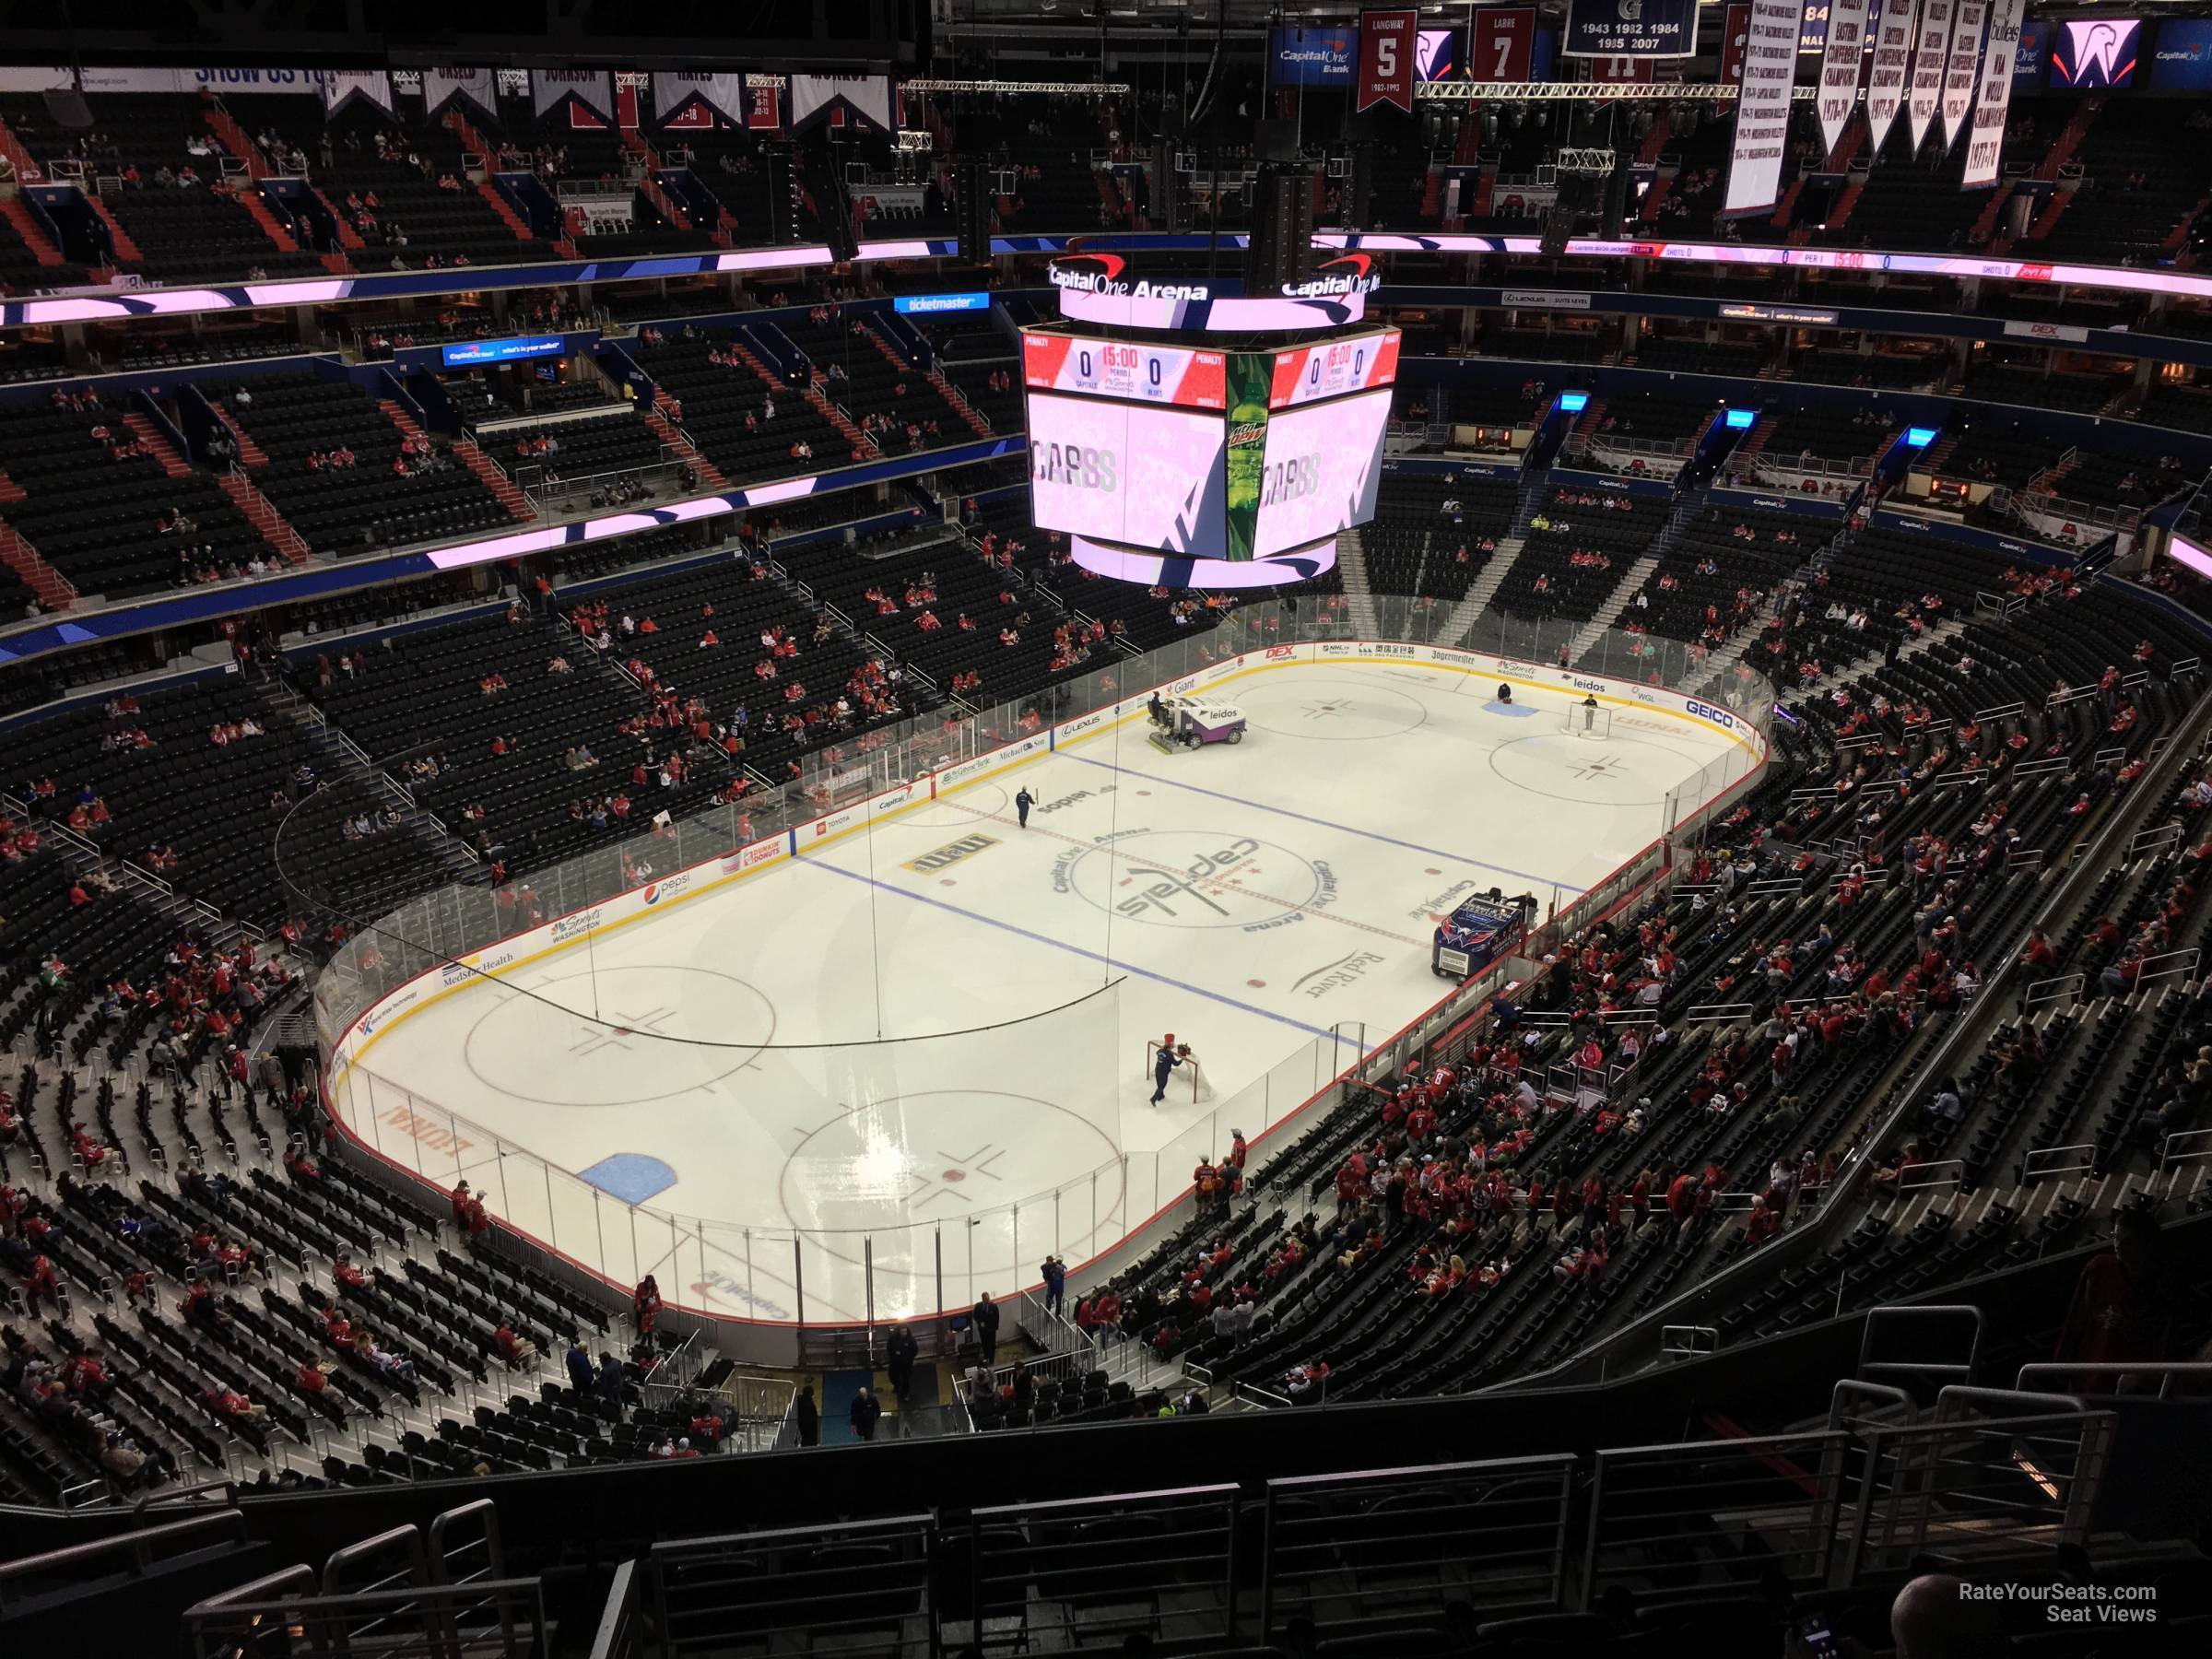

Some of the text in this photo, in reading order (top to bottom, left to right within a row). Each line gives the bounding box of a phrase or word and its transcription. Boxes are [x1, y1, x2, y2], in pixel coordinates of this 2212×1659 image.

[1372, 19, 1405, 30] LANGWAY
[1493, 18, 1516, 29] LABRE
[1582, 23, 1680, 34] 1943 1982 1984
[1836, 22, 1859, 41] EASTERN
[1991, 19, 2019, 42] bullets
[1630, 38, 1660, 50] 2007
[1377, 38, 1397, 77] 5
[1494, 37, 1512, 77] 7
[1827, 44, 1862, 65] CONFERENCE
[1876, 48, 1906, 66] CONFERENCE
[1825, 67, 1856, 87] CHAMPIONS
[1974, 107, 2006, 128] CHAMPIONS
[1805, 253, 1818, 264] PER
[1133, 280, 1208, 301] Arena
[909, 298, 972, 311] ticketmaster
[2030, 324, 2058, 335] DEX
[1080, 350, 1091, 377] 0
[1102, 346, 1138, 368] 15:00
[1328, 345, 1352, 367] 15:00
[1354, 349, 1364, 375] 0
[1149, 358, 1161, 385] 0
[1311, 358, 1321, 384] 0
[1265, 646, 1294, 659] DEX
[1174, 678, 1195, 695] Giant
[1573, 677, 1606, 692] leidos
[1071, 715, 1101, 732] LEXUS
[1209, 708, 1238, 721] leidos
[1686, 700, 1734, 728] GEICO
[1037, 790, 1096, 814] leidos
[828, 815, 850, 829] TOYOTA
[753, 847, 781, 863] DONUTS
[660, 873, 690, 893] pepsi
[552, 921, 601, 943] WASHINGTON
[1305, 950, 1386, 999] Red River
